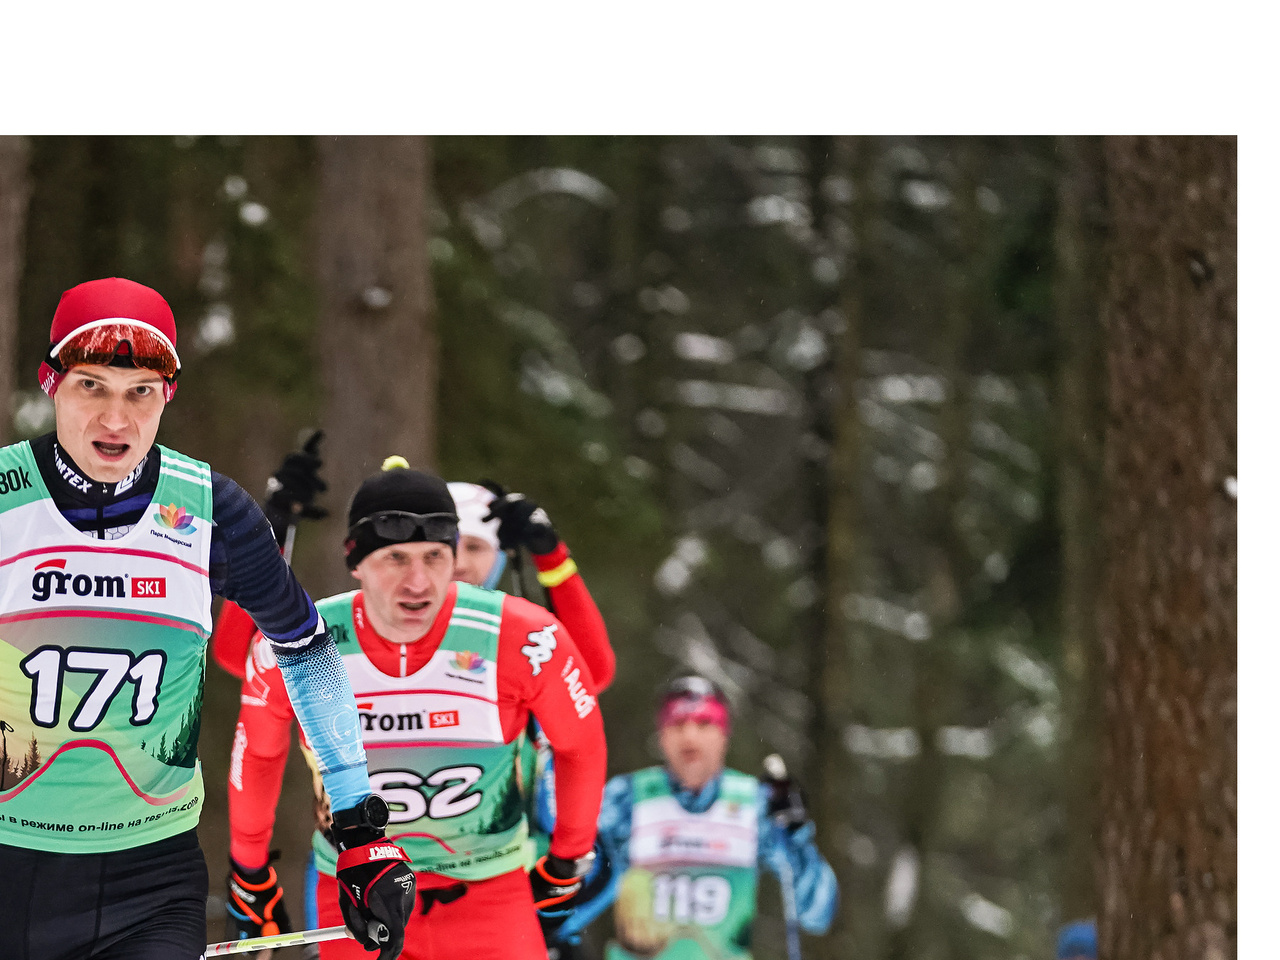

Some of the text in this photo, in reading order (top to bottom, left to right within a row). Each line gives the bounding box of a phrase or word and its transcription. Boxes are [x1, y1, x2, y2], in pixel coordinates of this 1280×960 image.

[31, 569, 162, 602] grom SKI
[19, 644, 167, 732] 171
[358, 712, 424, 732] rom
[368, 763, 485, 825] 62
[21, 818, 75, 833] режиме
[78, 821, 125, 832] on-line
[127, 818, 142, 828] на
